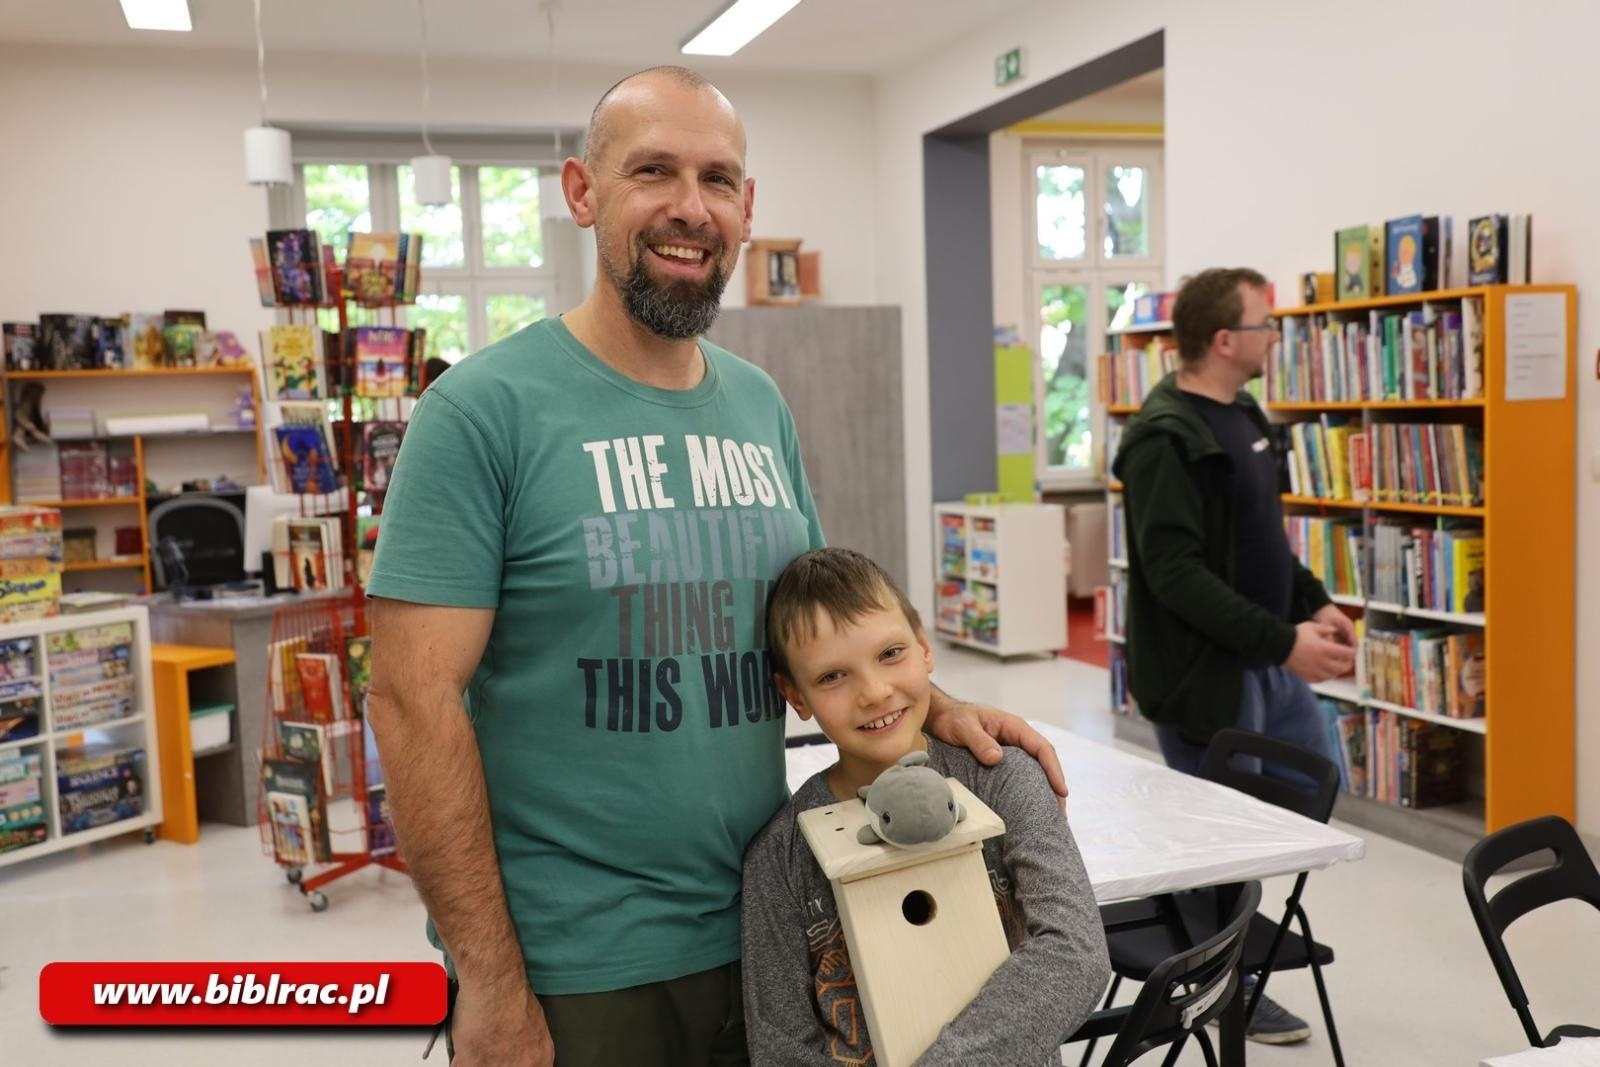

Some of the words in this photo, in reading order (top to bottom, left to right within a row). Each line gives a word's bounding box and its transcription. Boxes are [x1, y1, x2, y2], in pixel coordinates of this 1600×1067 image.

[583, 434, 674, 512] THE
[685, 434, 790, 509] MOST
[611, 580, 736, 657] THING
[577, 658, 683, 733] THIS
[701, 651, 786, 728] WOR
